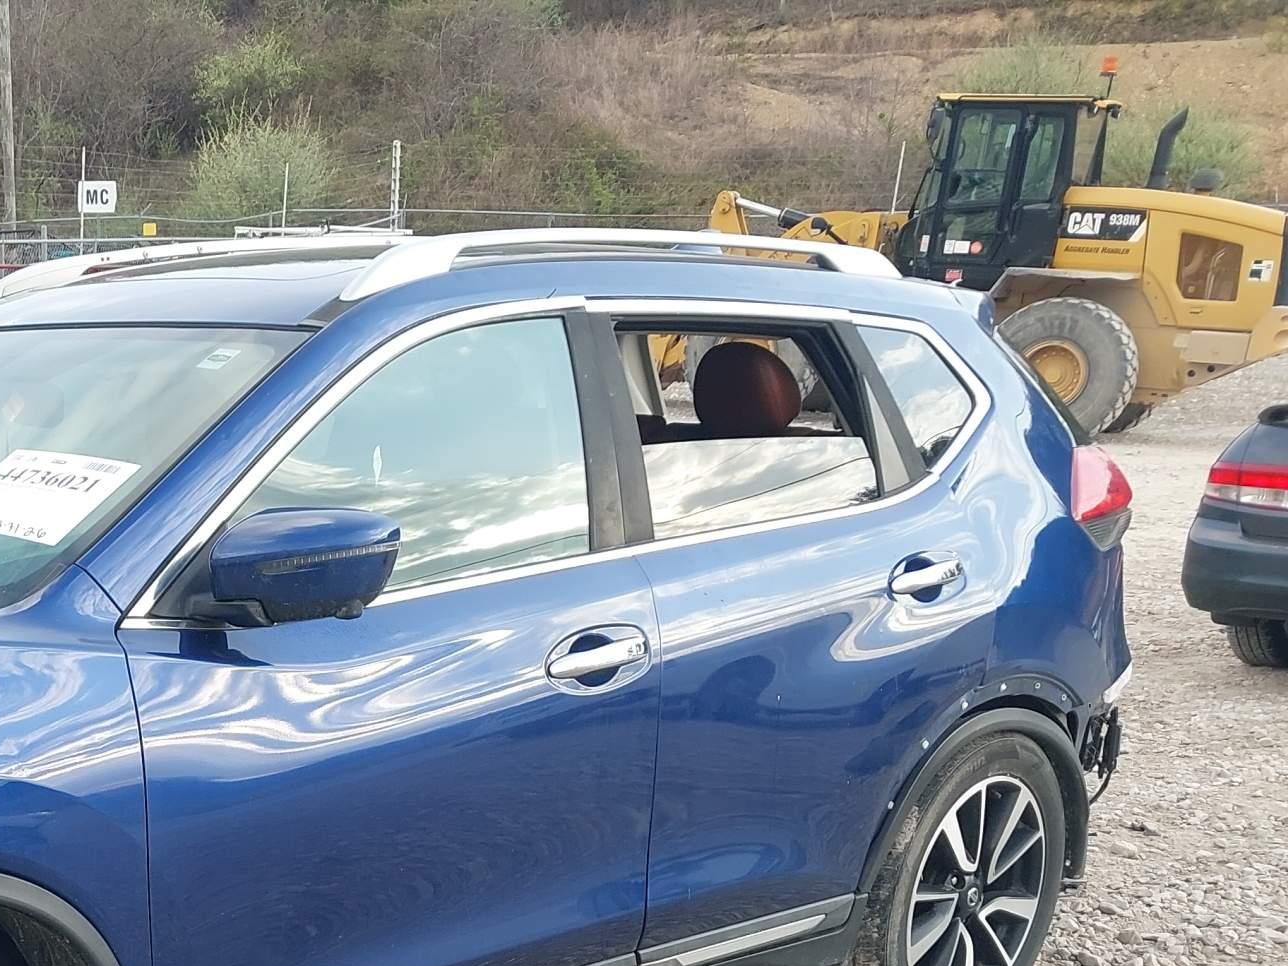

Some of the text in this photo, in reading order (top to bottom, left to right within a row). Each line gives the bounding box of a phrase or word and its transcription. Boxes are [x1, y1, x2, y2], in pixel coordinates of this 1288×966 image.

[86, 189, 109, 205] MC
[1067, 212, 1141, 234] CAT 938M
[0, 467, 101, 493] 44736021
